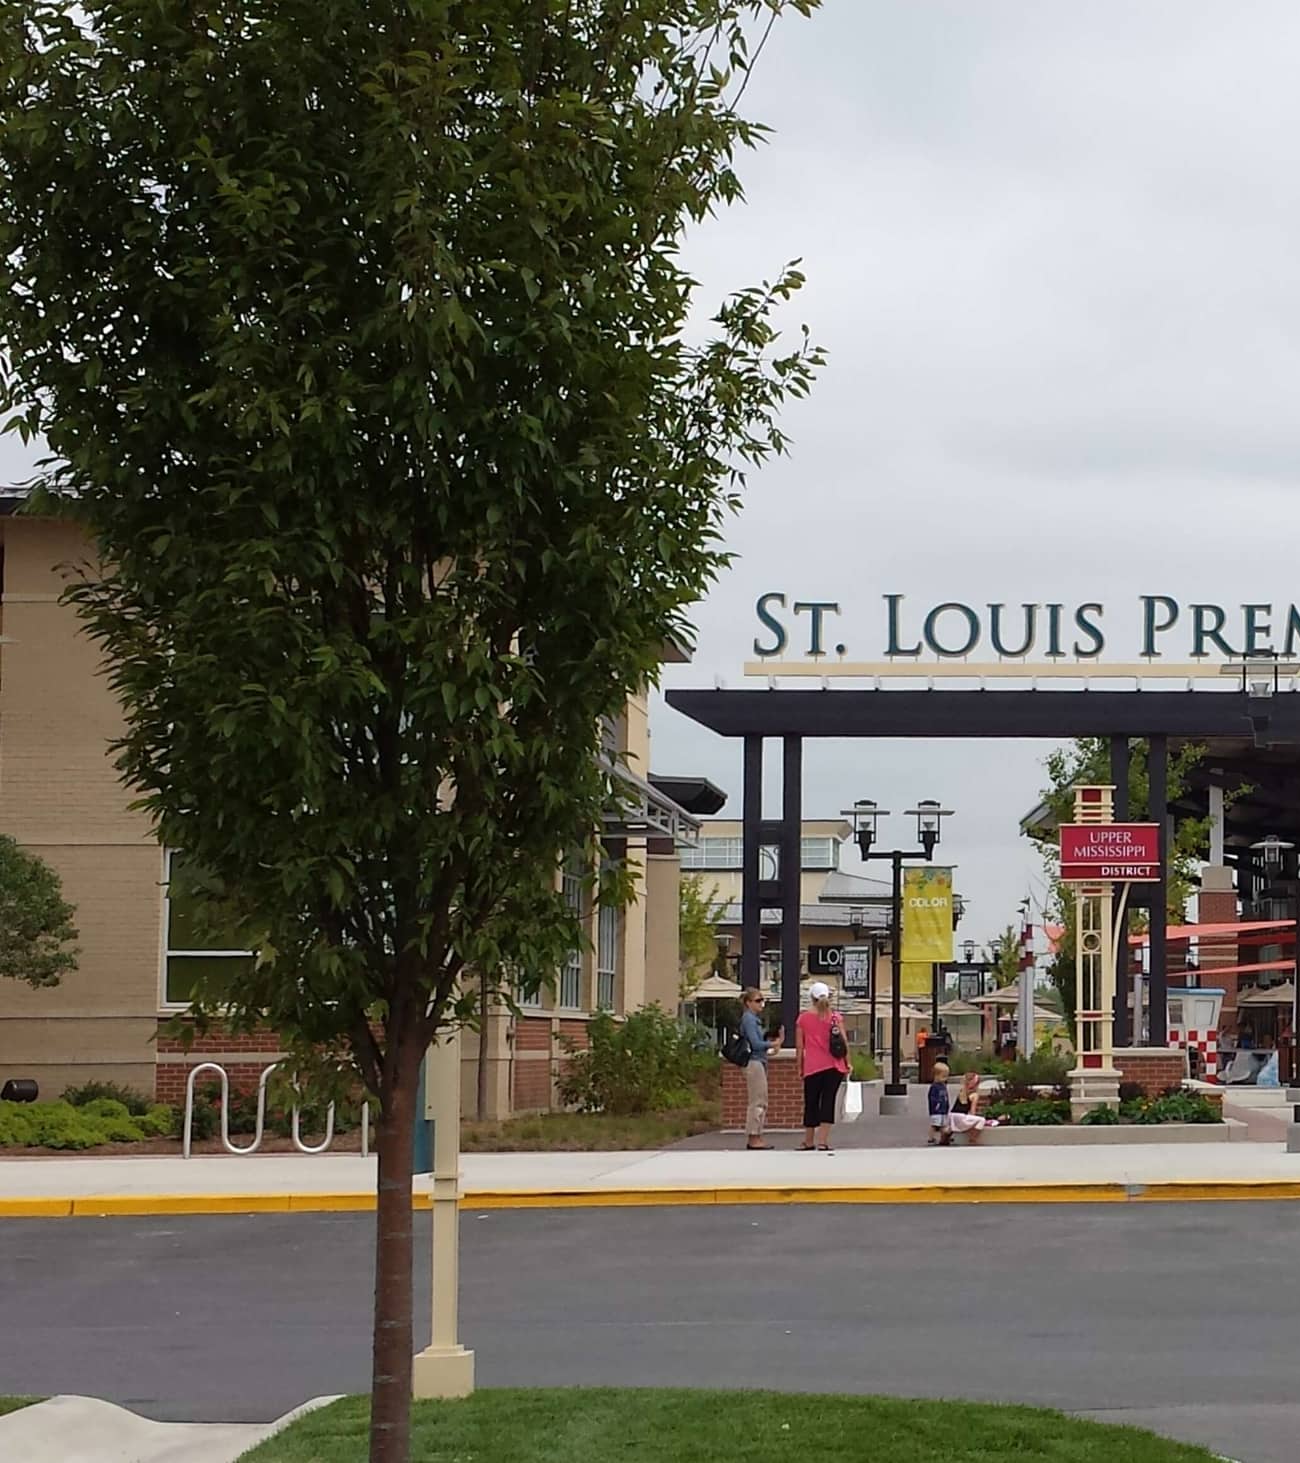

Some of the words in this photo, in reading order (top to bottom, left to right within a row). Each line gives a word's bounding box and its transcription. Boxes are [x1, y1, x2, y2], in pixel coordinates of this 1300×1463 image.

[753, 592, 847, 657] ST.
[882, 593, 1105, 658] LOUIS
[1090, 831, 1132, 844] UPPER
[1073, 845, 1146, 858] MISSISSIPPI
[1101, 866, 1152, 876] DISTRICT
